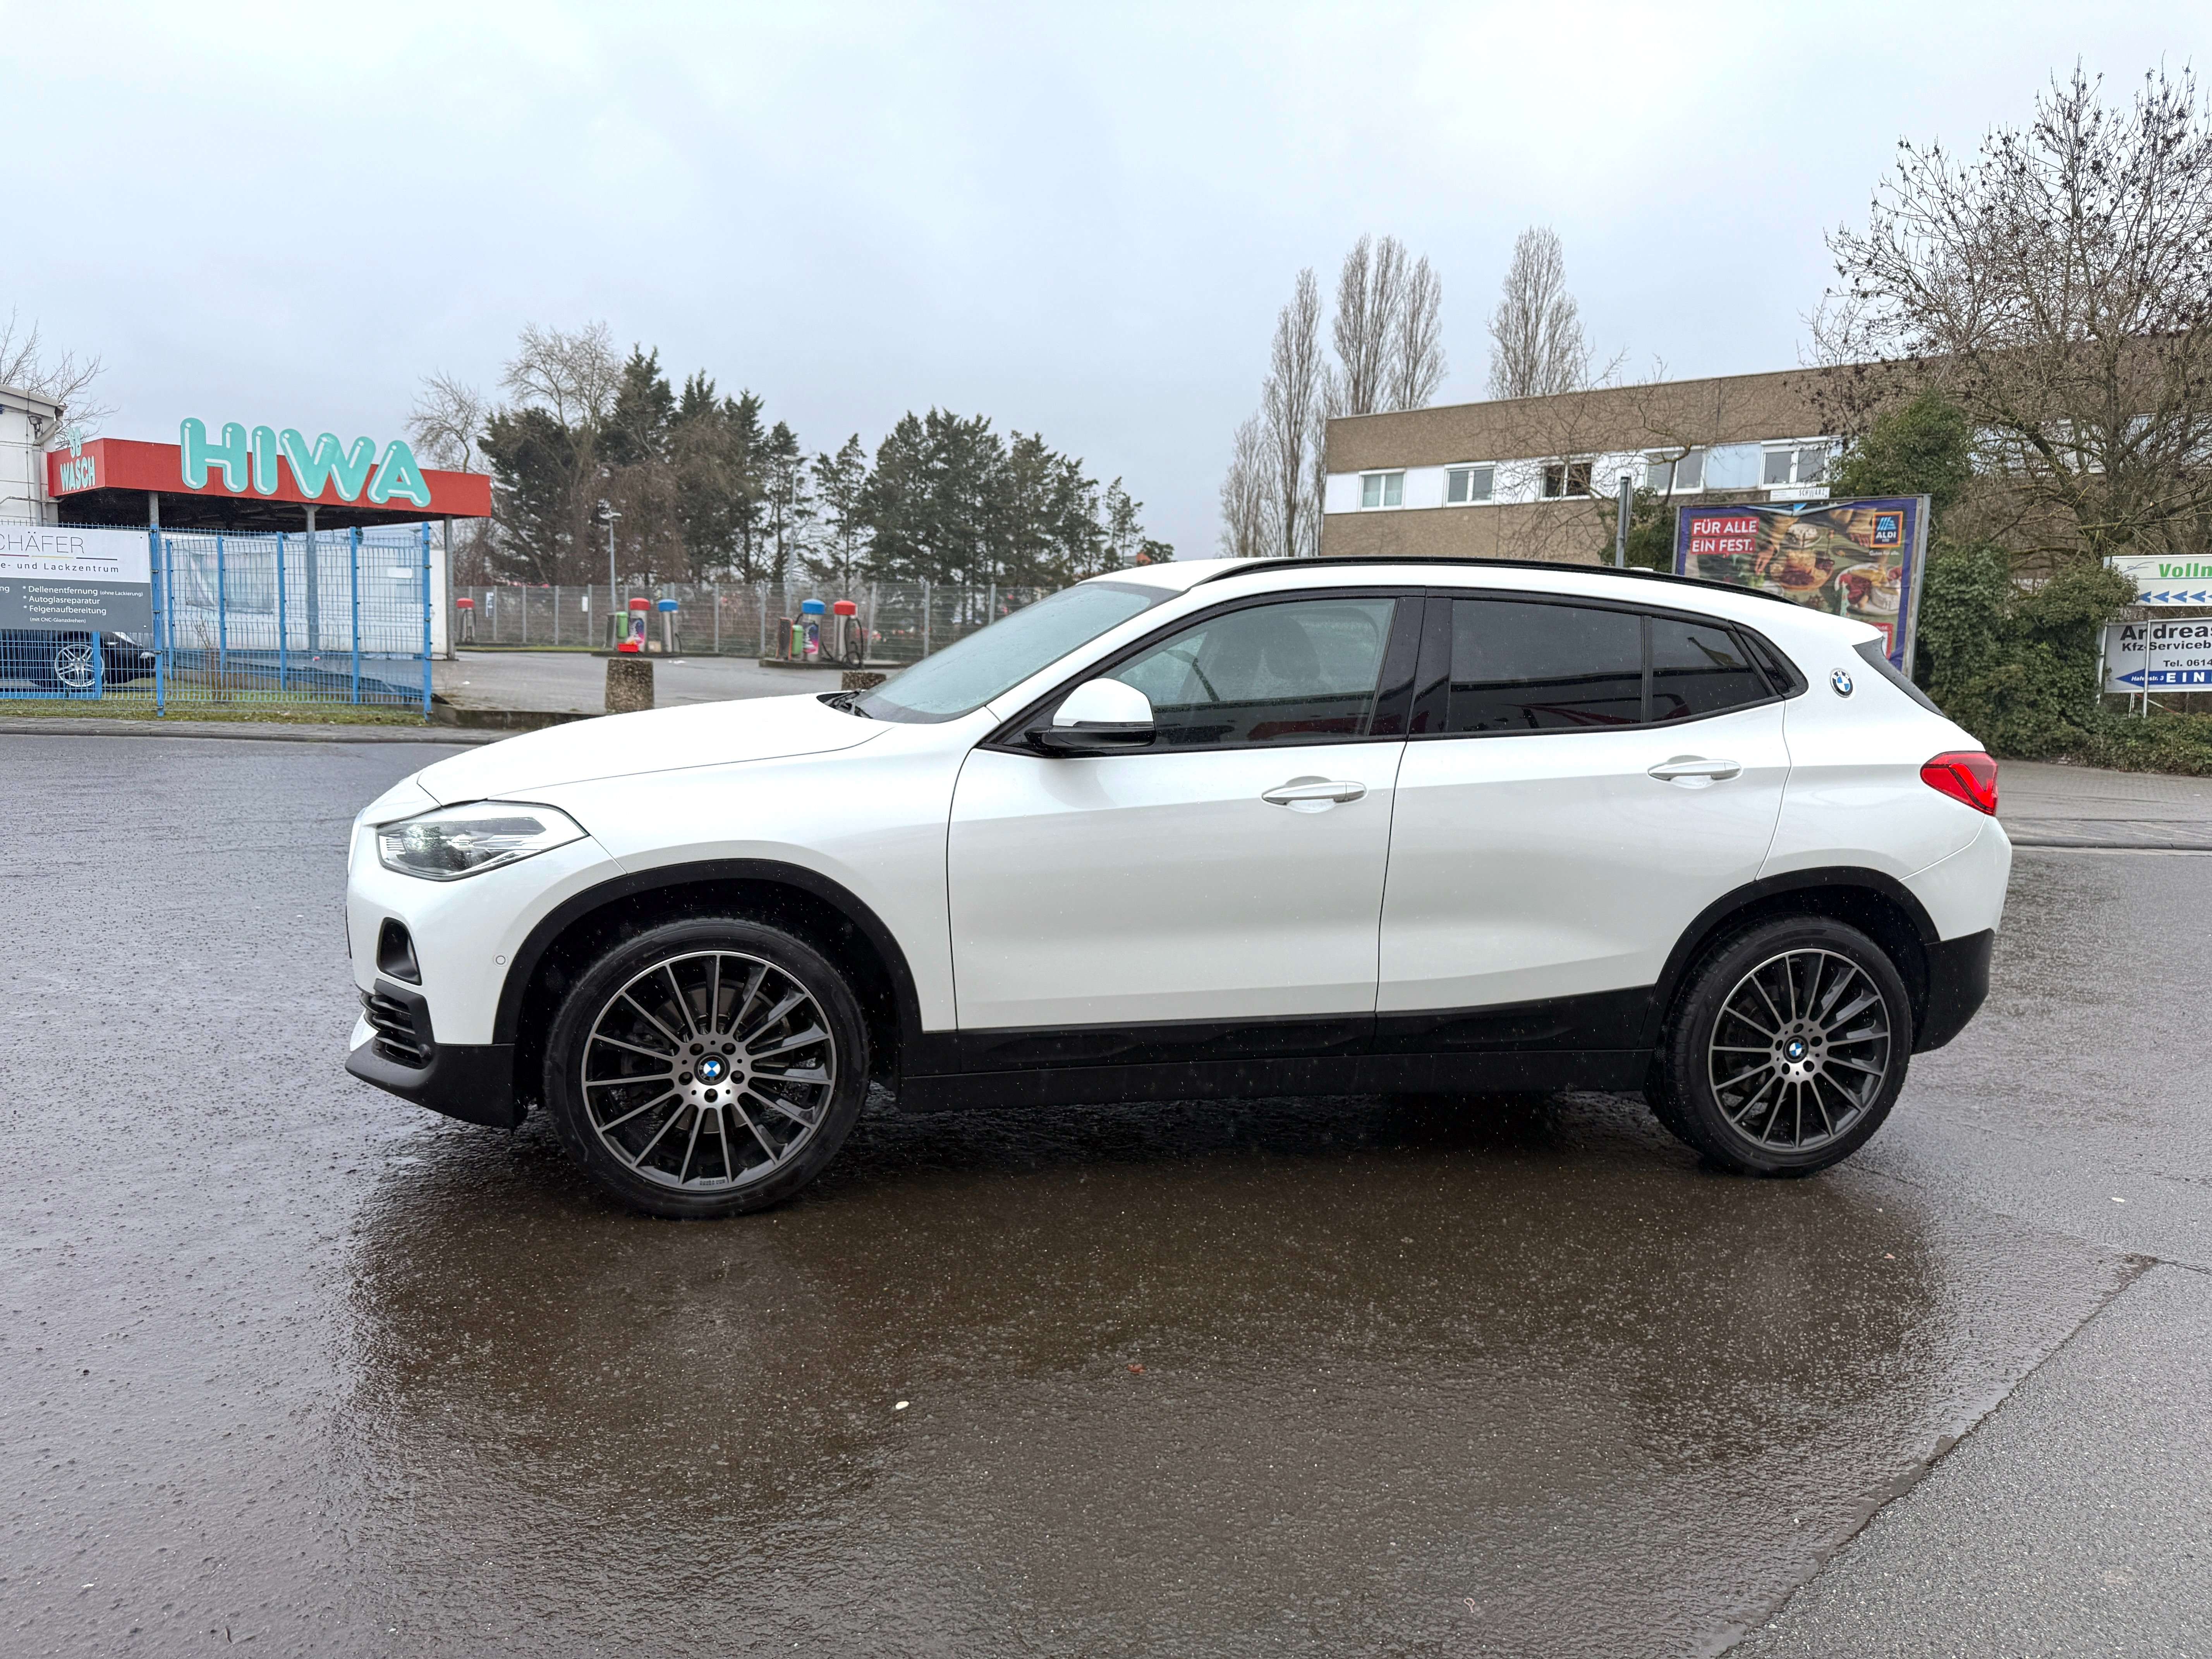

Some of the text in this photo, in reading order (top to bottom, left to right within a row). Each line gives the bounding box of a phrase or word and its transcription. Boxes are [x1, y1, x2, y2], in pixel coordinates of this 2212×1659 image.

[180, 417, 431, 507] HIWA
[60, 455, 95, 492] WASCH
[1693, 519, 1757, 534] FÜR ALLE
[1692, 539, 1753, 552] EIN FEST.
[44, 563, 118, 573] Lackzentrum
[29, 586, 98, 596] Dellenentfernung
[29, 595, 100, 605] Autoglasreparatur
[29, 605, 106, 615] Felgenaufbereitung
[2120, 624, 2212, 640] Andrea
[1832, 670, 1850, 680] BMW
